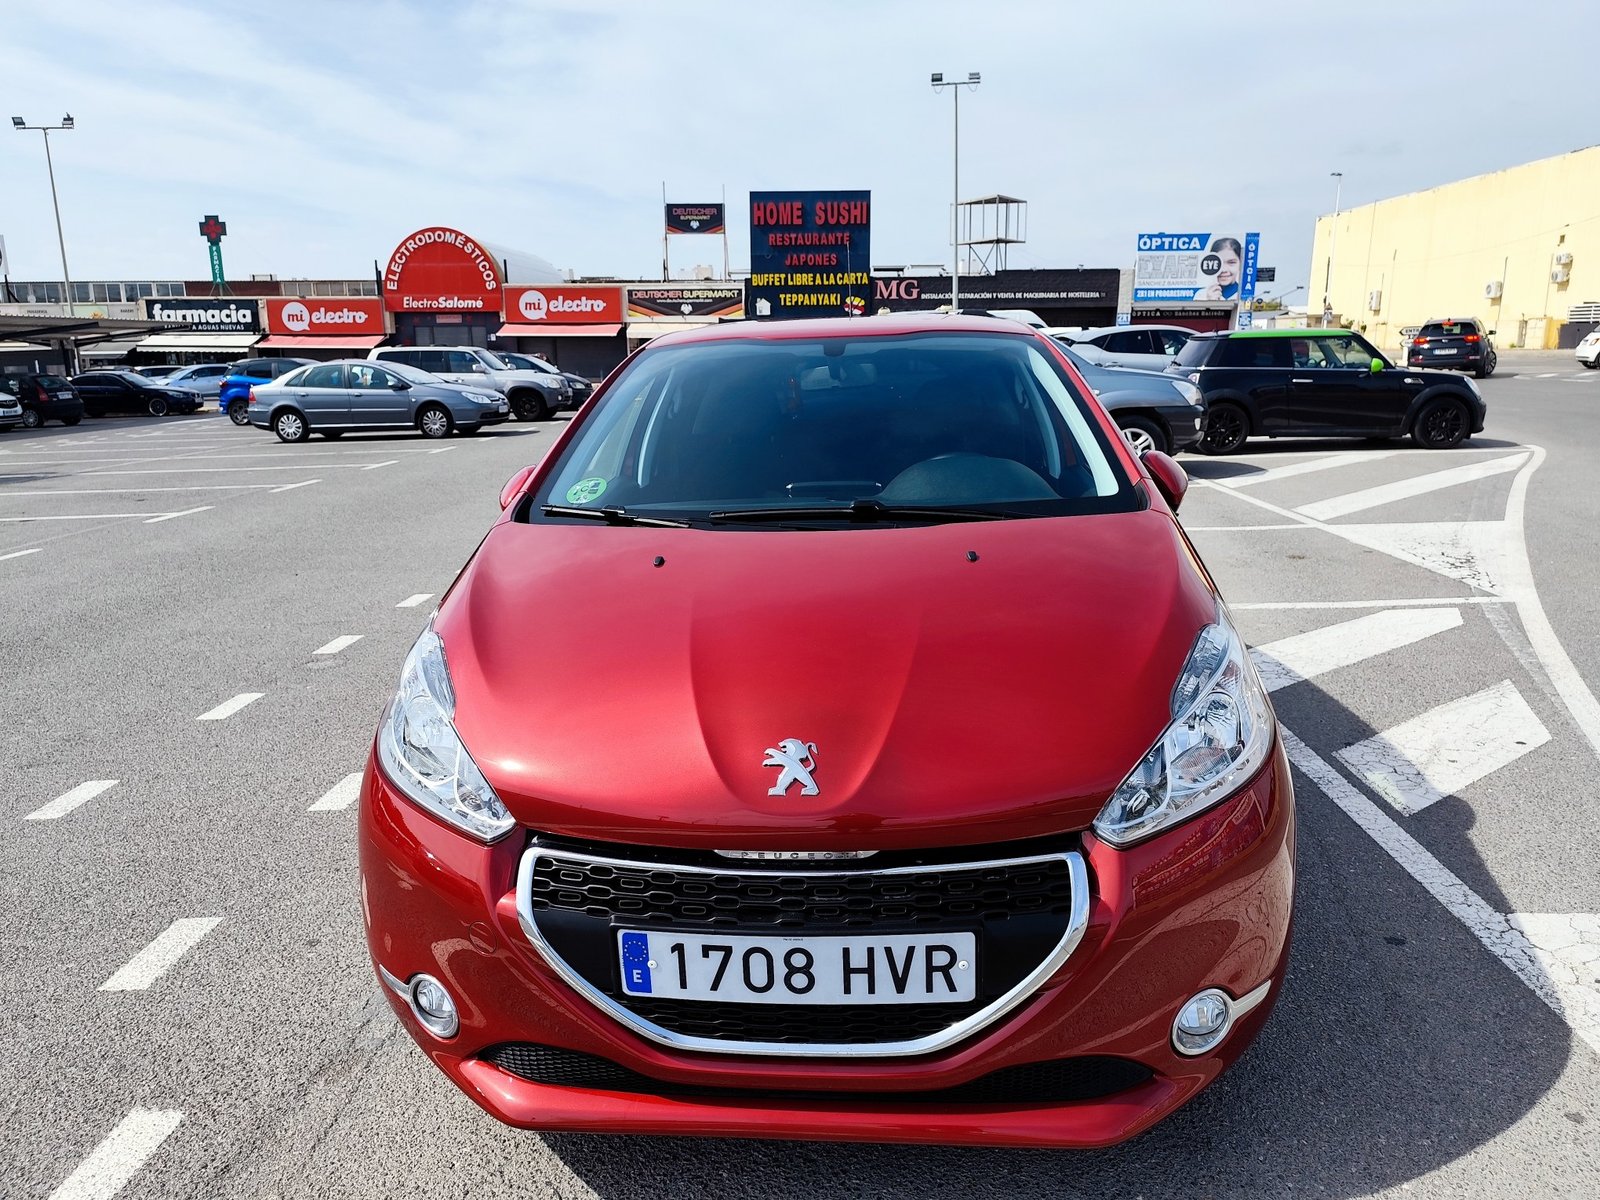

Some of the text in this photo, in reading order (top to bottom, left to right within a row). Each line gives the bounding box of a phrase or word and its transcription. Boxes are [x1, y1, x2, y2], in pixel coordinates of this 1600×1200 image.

[672, 207, 718, 216] DEUTSCHER
[753, 201, 868, 226] HOME SUSHI
[768, 232, 850, 246] RESTAURANTE
[1139, 234, 1201, 250] ÓPTICA
[212, 246, 221, 282] FARMACIA
[386, 230, 497, 291] ELECTRODOMÉSTICOS
[785, 253, 837, 266] JAPONES
[1202, 260, 1219, 270] EYE
[752, 272, 869, 287] BUFFET LIBRE A LA CARTA
[632, 290, 739, 299] DEUTSCHER SUPERMARKT
[875, 279, 920, 300] MG
[1060, 291, 1068, 299] DE
[524, 296, 606, 312] mi electro
[779, 293, 841, 306] TEPPANYAKI
[152, 303, 252, 323] farmacia
[287, 307, 368, 324] mi electro
[633, 969, 643, 984] E
[669, 942, 959, 995] 1708 HVR
